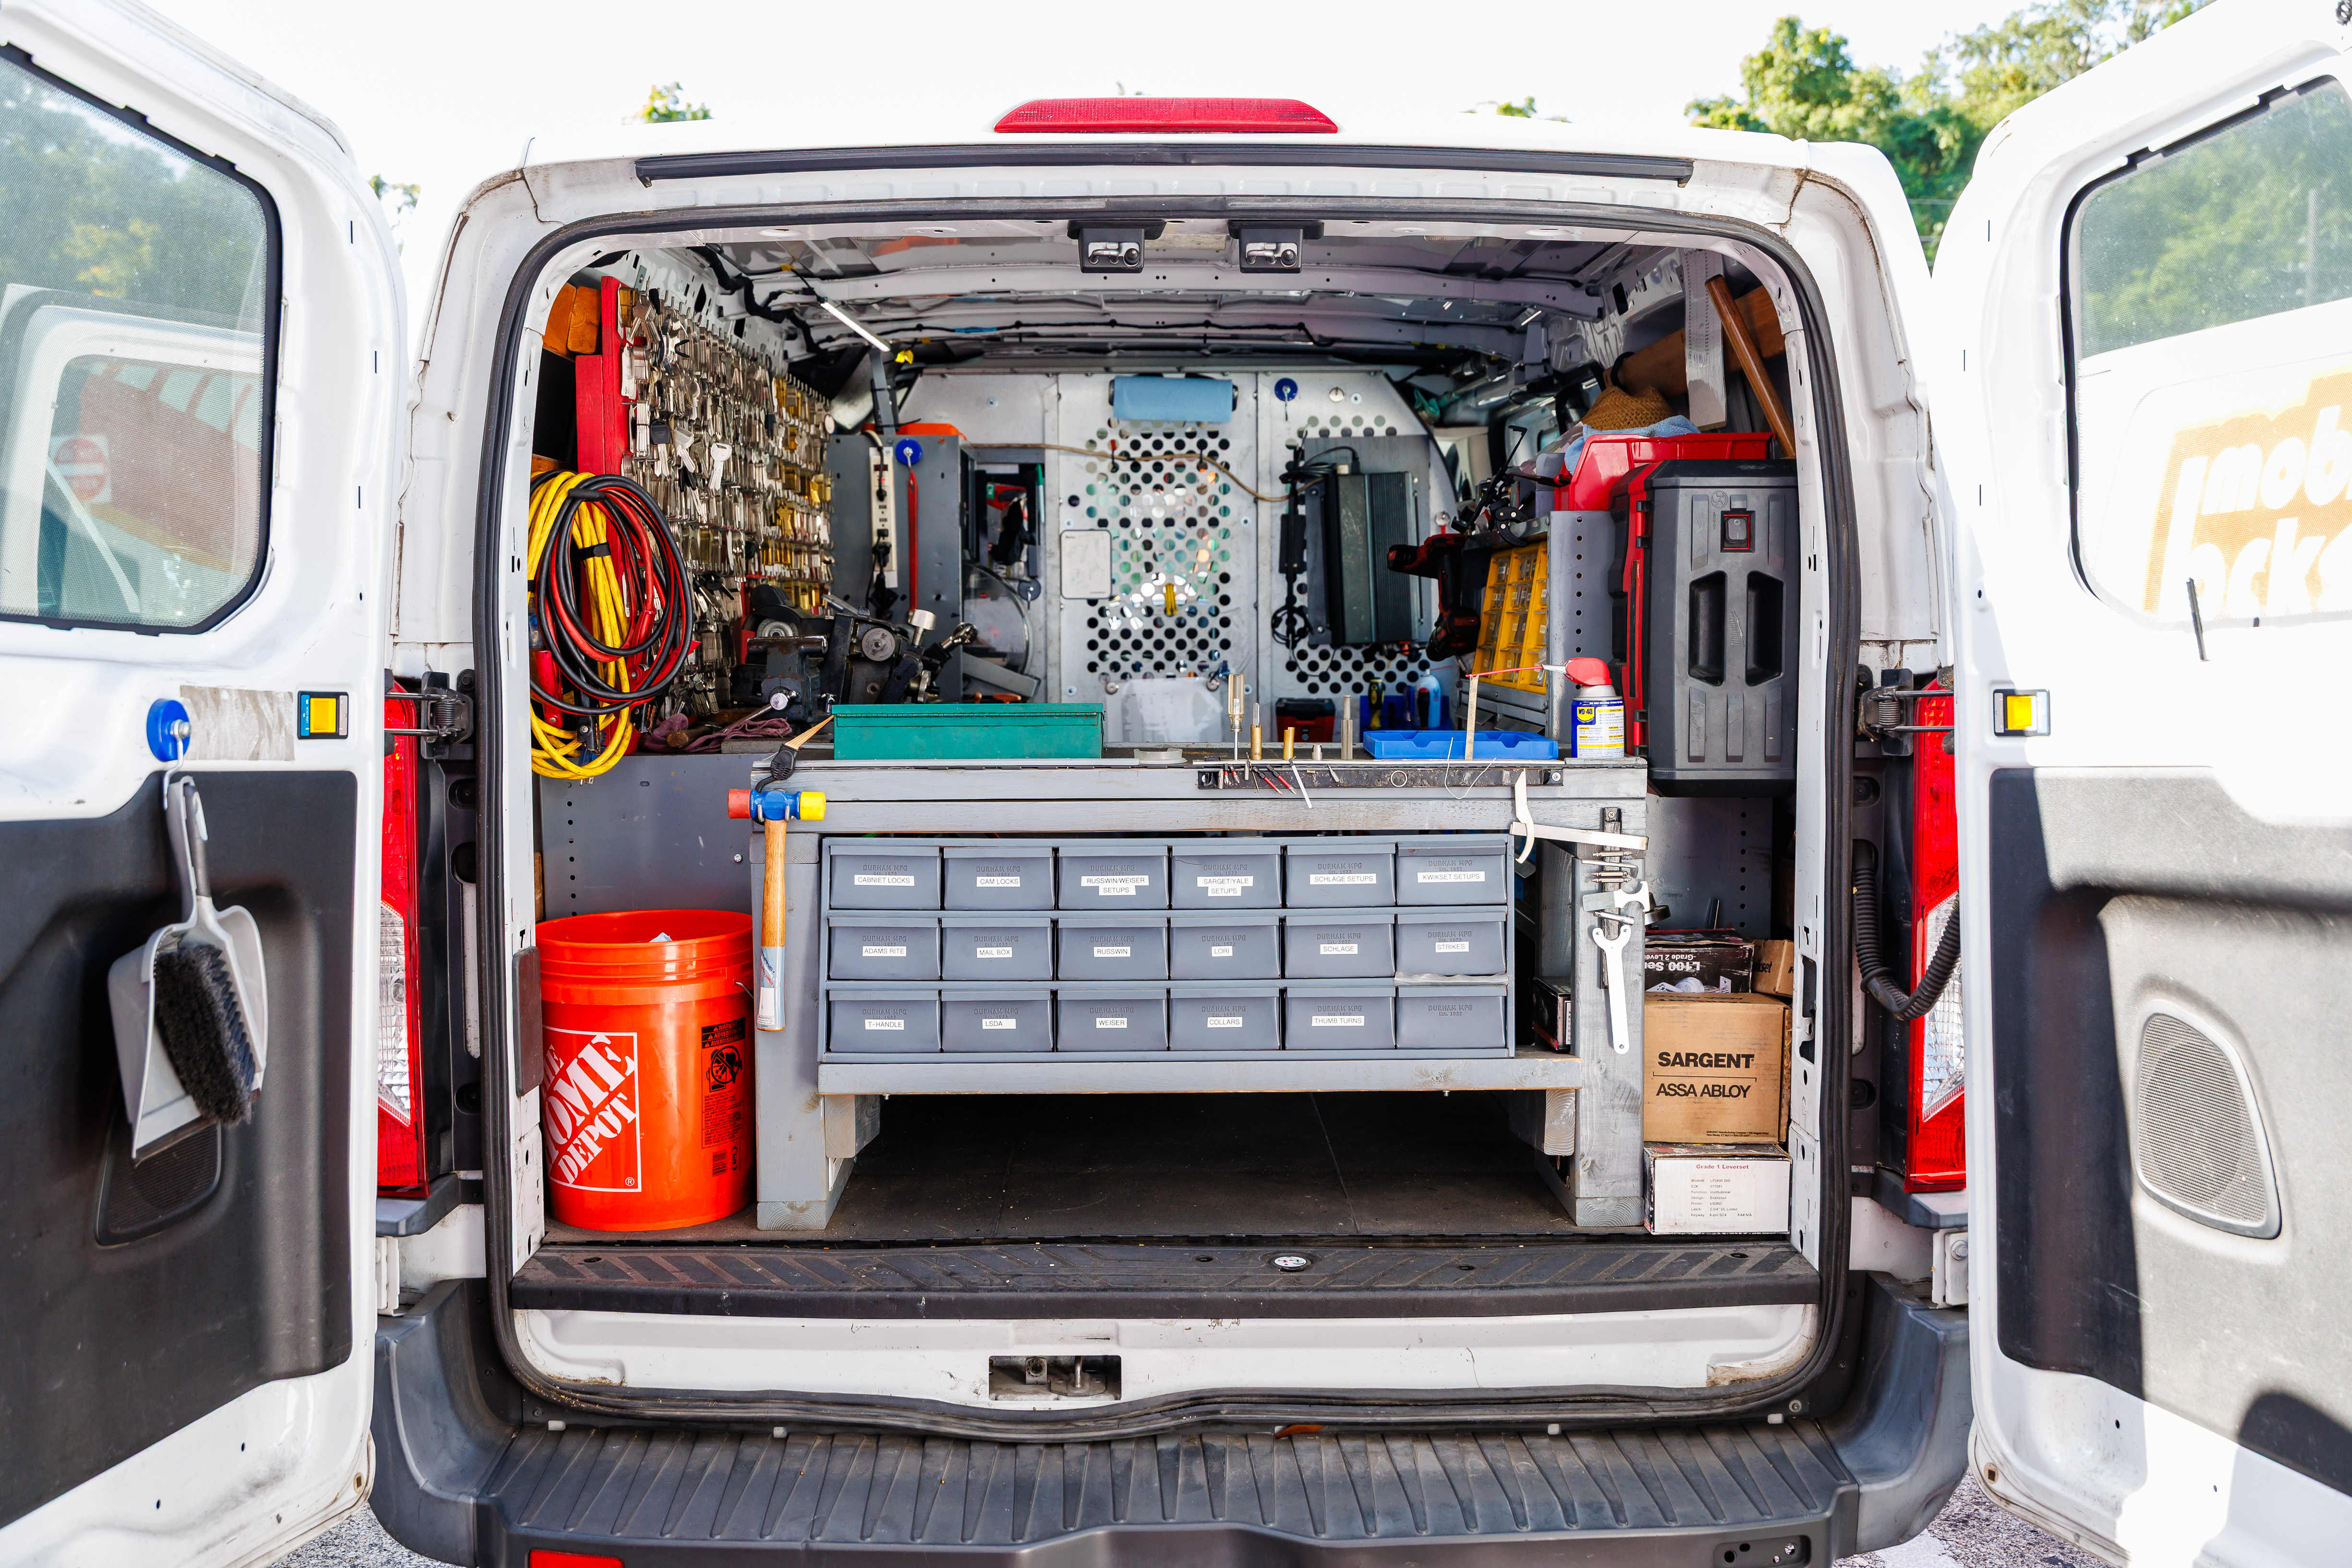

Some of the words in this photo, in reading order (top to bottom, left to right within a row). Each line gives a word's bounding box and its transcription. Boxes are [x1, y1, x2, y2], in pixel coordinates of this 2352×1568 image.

[1728, 610, 1741, 648] Milwaukee
[1668, 961, 1700, 971] L100
[718, 1021, 738, 1031] WARNING
[1658, 1051, 1755, 1069] SARGENT
[1656, 1082, 1697, 1097] ASSA
[1700, 1083, 1751, 1098] ABLOY
[558, 1092, 637, 1185] DEPOT
